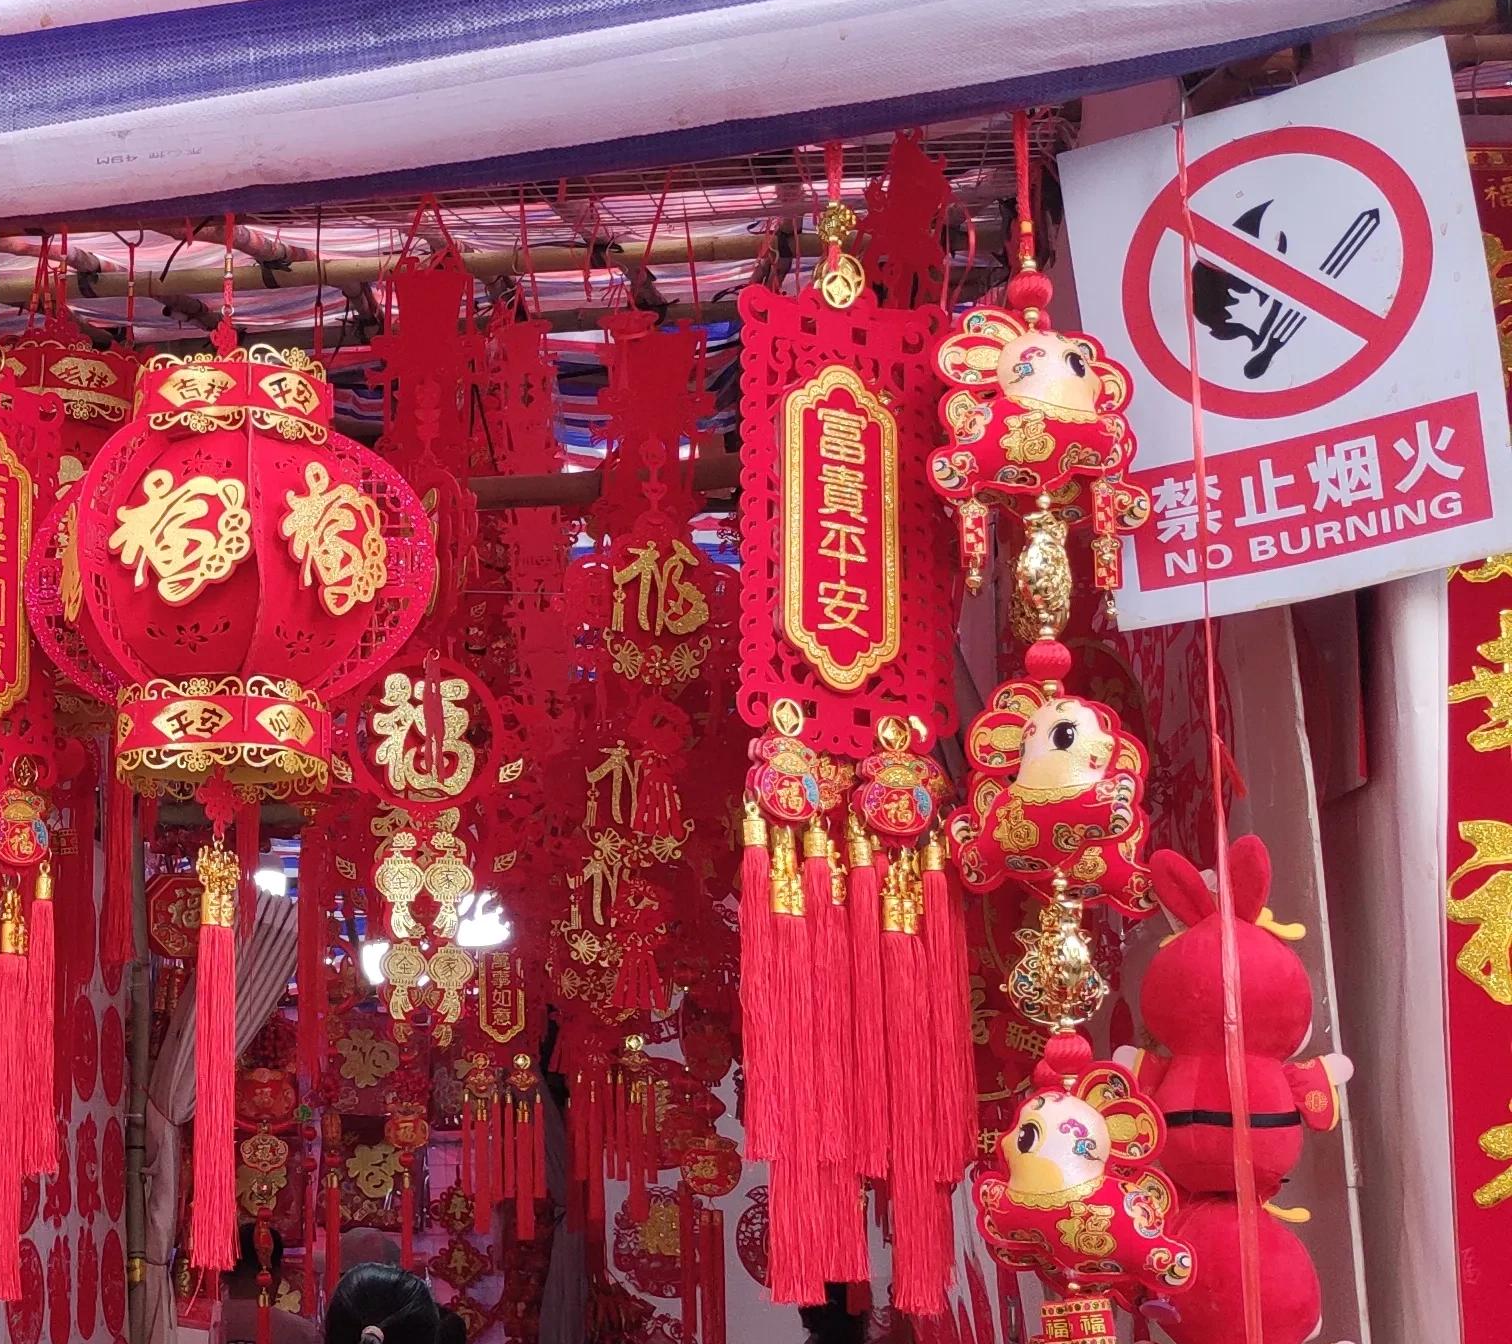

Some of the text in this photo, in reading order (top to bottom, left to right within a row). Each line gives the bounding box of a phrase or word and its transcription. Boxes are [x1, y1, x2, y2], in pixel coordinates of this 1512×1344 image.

[172, 377, 231, 401] 吉祥
[267, 377, 317, 414] 平安
[1152, 420, 1466, 544] 禁止烟火
[1163, 491, 1463, 577] NO BURNING
[165, 707, 224, 736] 平安
[373, 672, 475, 794] 福
[1046, 1316, 1069, 1339] 福
[1080, 1313, 1106, 1335] 福
